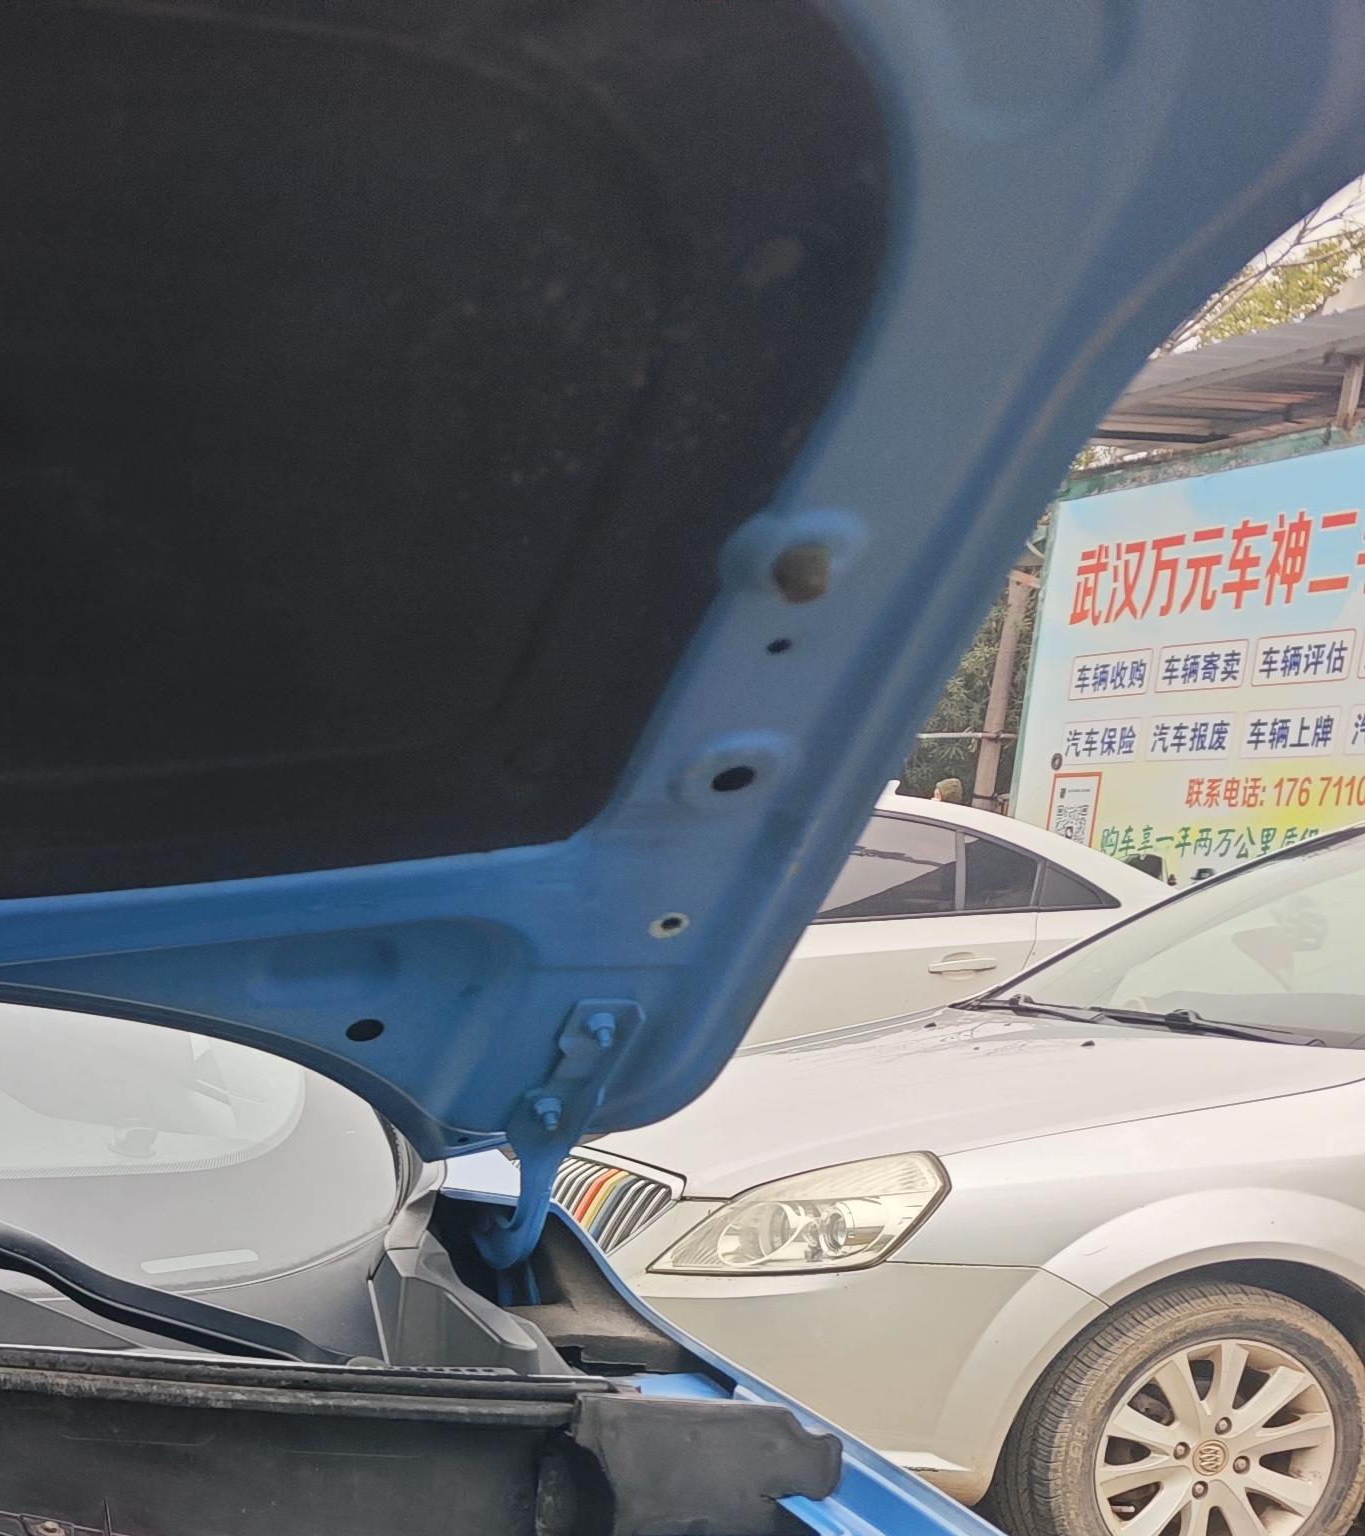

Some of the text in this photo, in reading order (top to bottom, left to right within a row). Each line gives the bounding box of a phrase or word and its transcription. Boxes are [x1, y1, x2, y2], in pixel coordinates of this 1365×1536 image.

[1069, 509, 1365, 626] 武汉万元车神二
[1074, 640, 1349, 694] 车辆收购 车辆寄卖 车辆评估
[1064, 725, 1137, 758] 汽车保险
[1150, 719, 1231, 754] 汽车报废
[1246, 714, 1335, 751] 车辆上牌
[1273, 775, 1313, 808] 176
